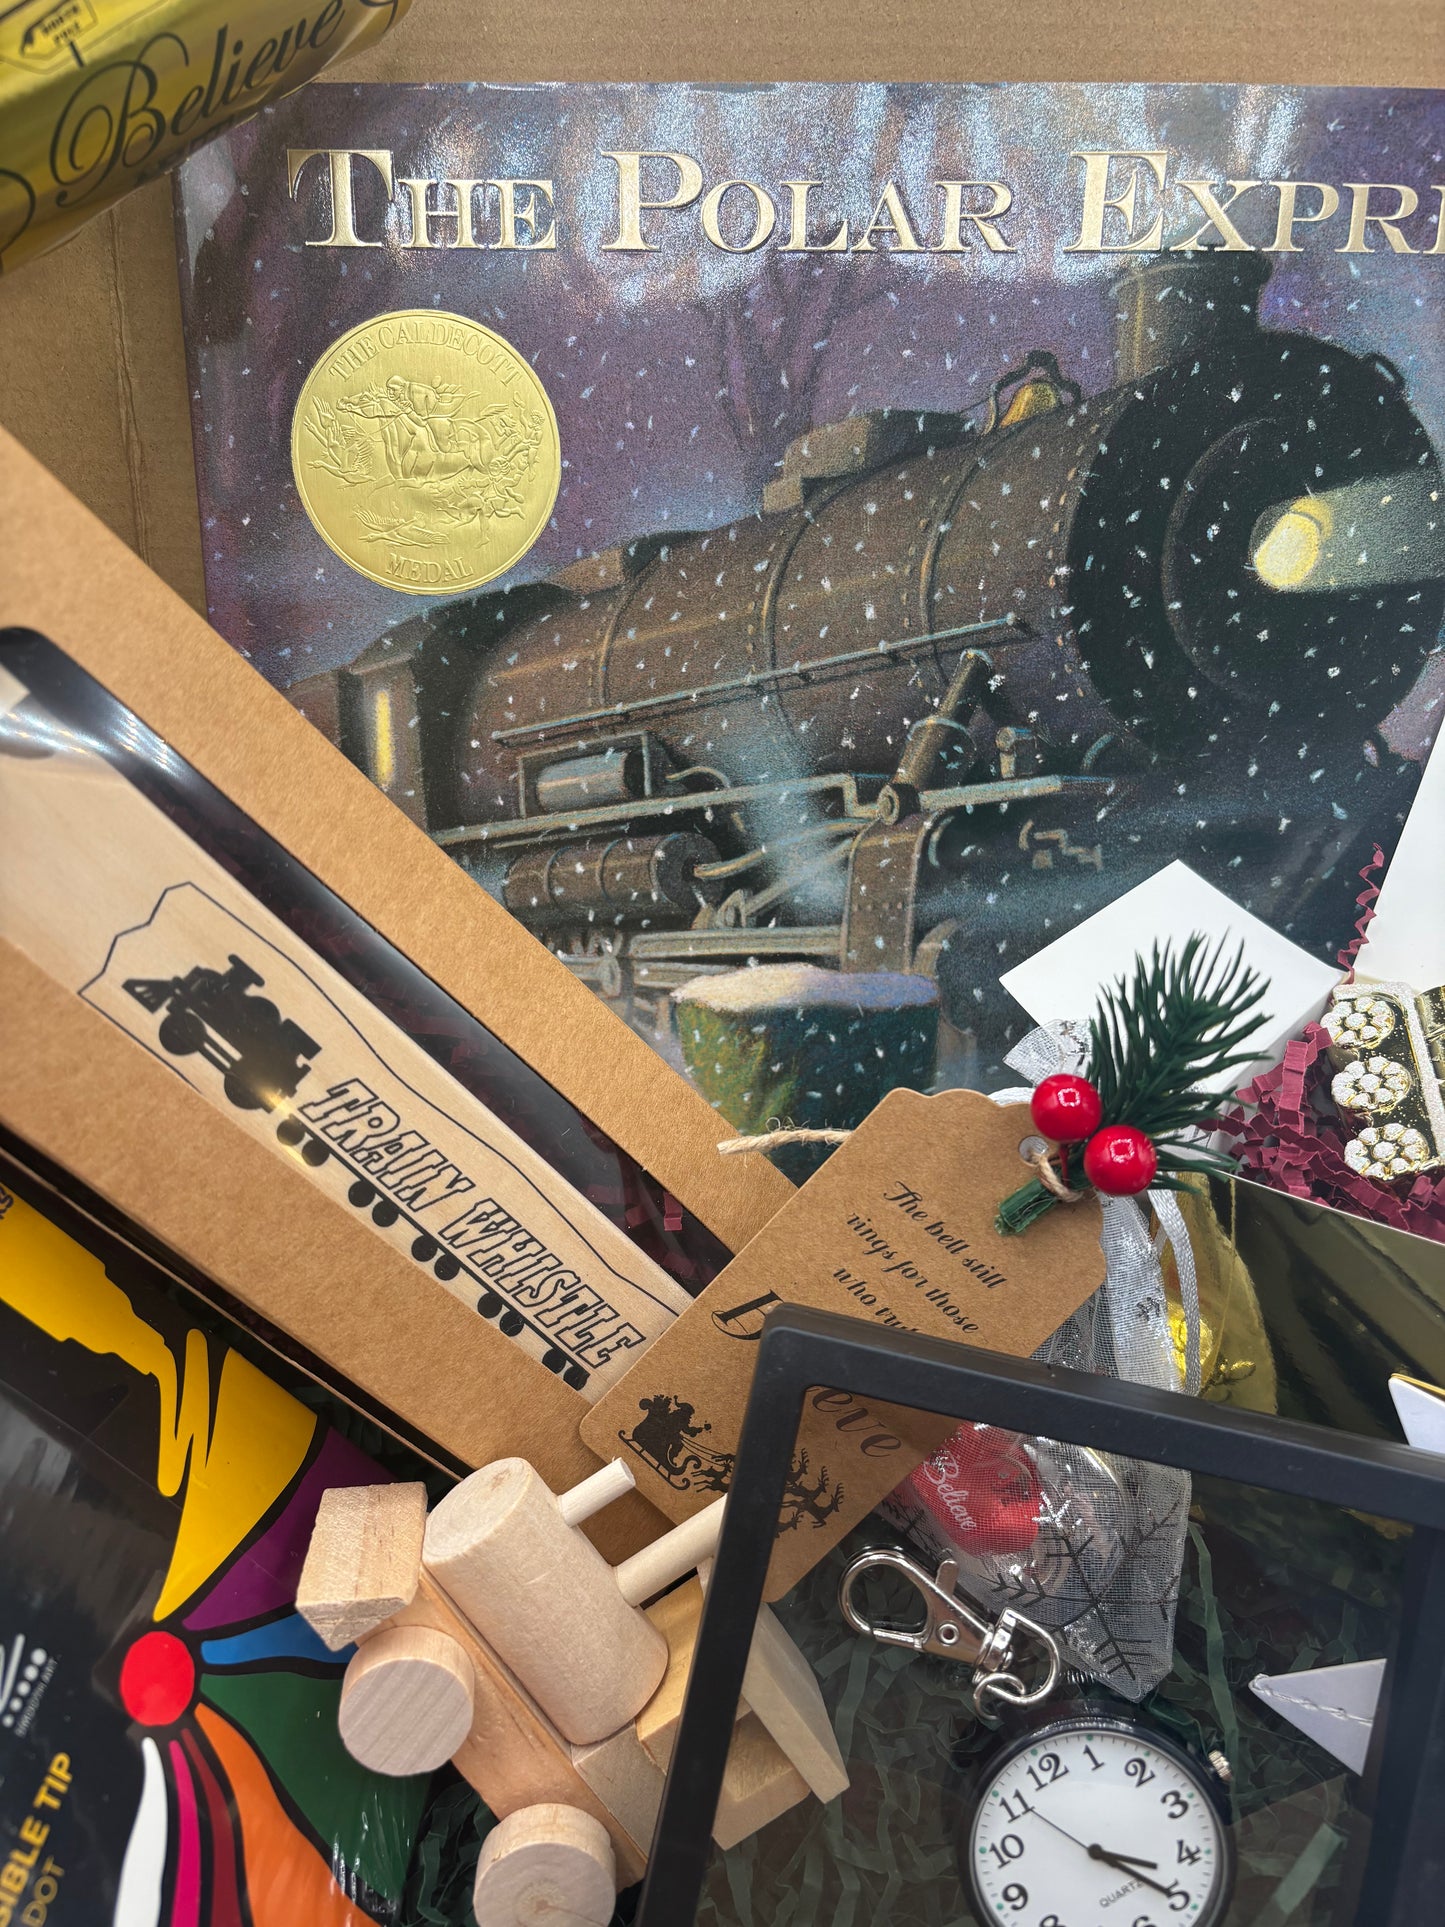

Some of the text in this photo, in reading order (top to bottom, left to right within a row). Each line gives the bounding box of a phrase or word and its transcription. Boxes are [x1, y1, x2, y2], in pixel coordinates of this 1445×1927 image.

[49, 0, 345, 208] Believe
[286, 148, 557, 251] THE
[600, 149, 1018, 254] POLAR
[328, 321, 525, 387] THE CALDECOTT
[385, 552, 473, 584] MEDAL
[299, 1077, 647, 1370] TRAIN WHISTLE
[883, 1180, 1008, 1290] The bell still
[832, 1265, 877, 1306] who
[846, 1212, 980, 1334] rings for those
[921, 1448, 978, 1532] Believe
[1025, 1752, 1070, 1792] 12
[1082, 1744, 1105, 1772] 1
[1123, 1757, 1156, 1788] 2
[33, 1752, 73, 1811] TIP
[998, 1788, 1036, 1824] 11
[1160, 1789, 1190, 1820] 3
[988, 1833, 1025, 1869] 10
[1175, 1839, 1202, 1867] 4
[21, 1855, 65, 1927] DOT
[1001, 1882, 1029, 1912] 9
[1166, 1878, 1191, 1912] 5
